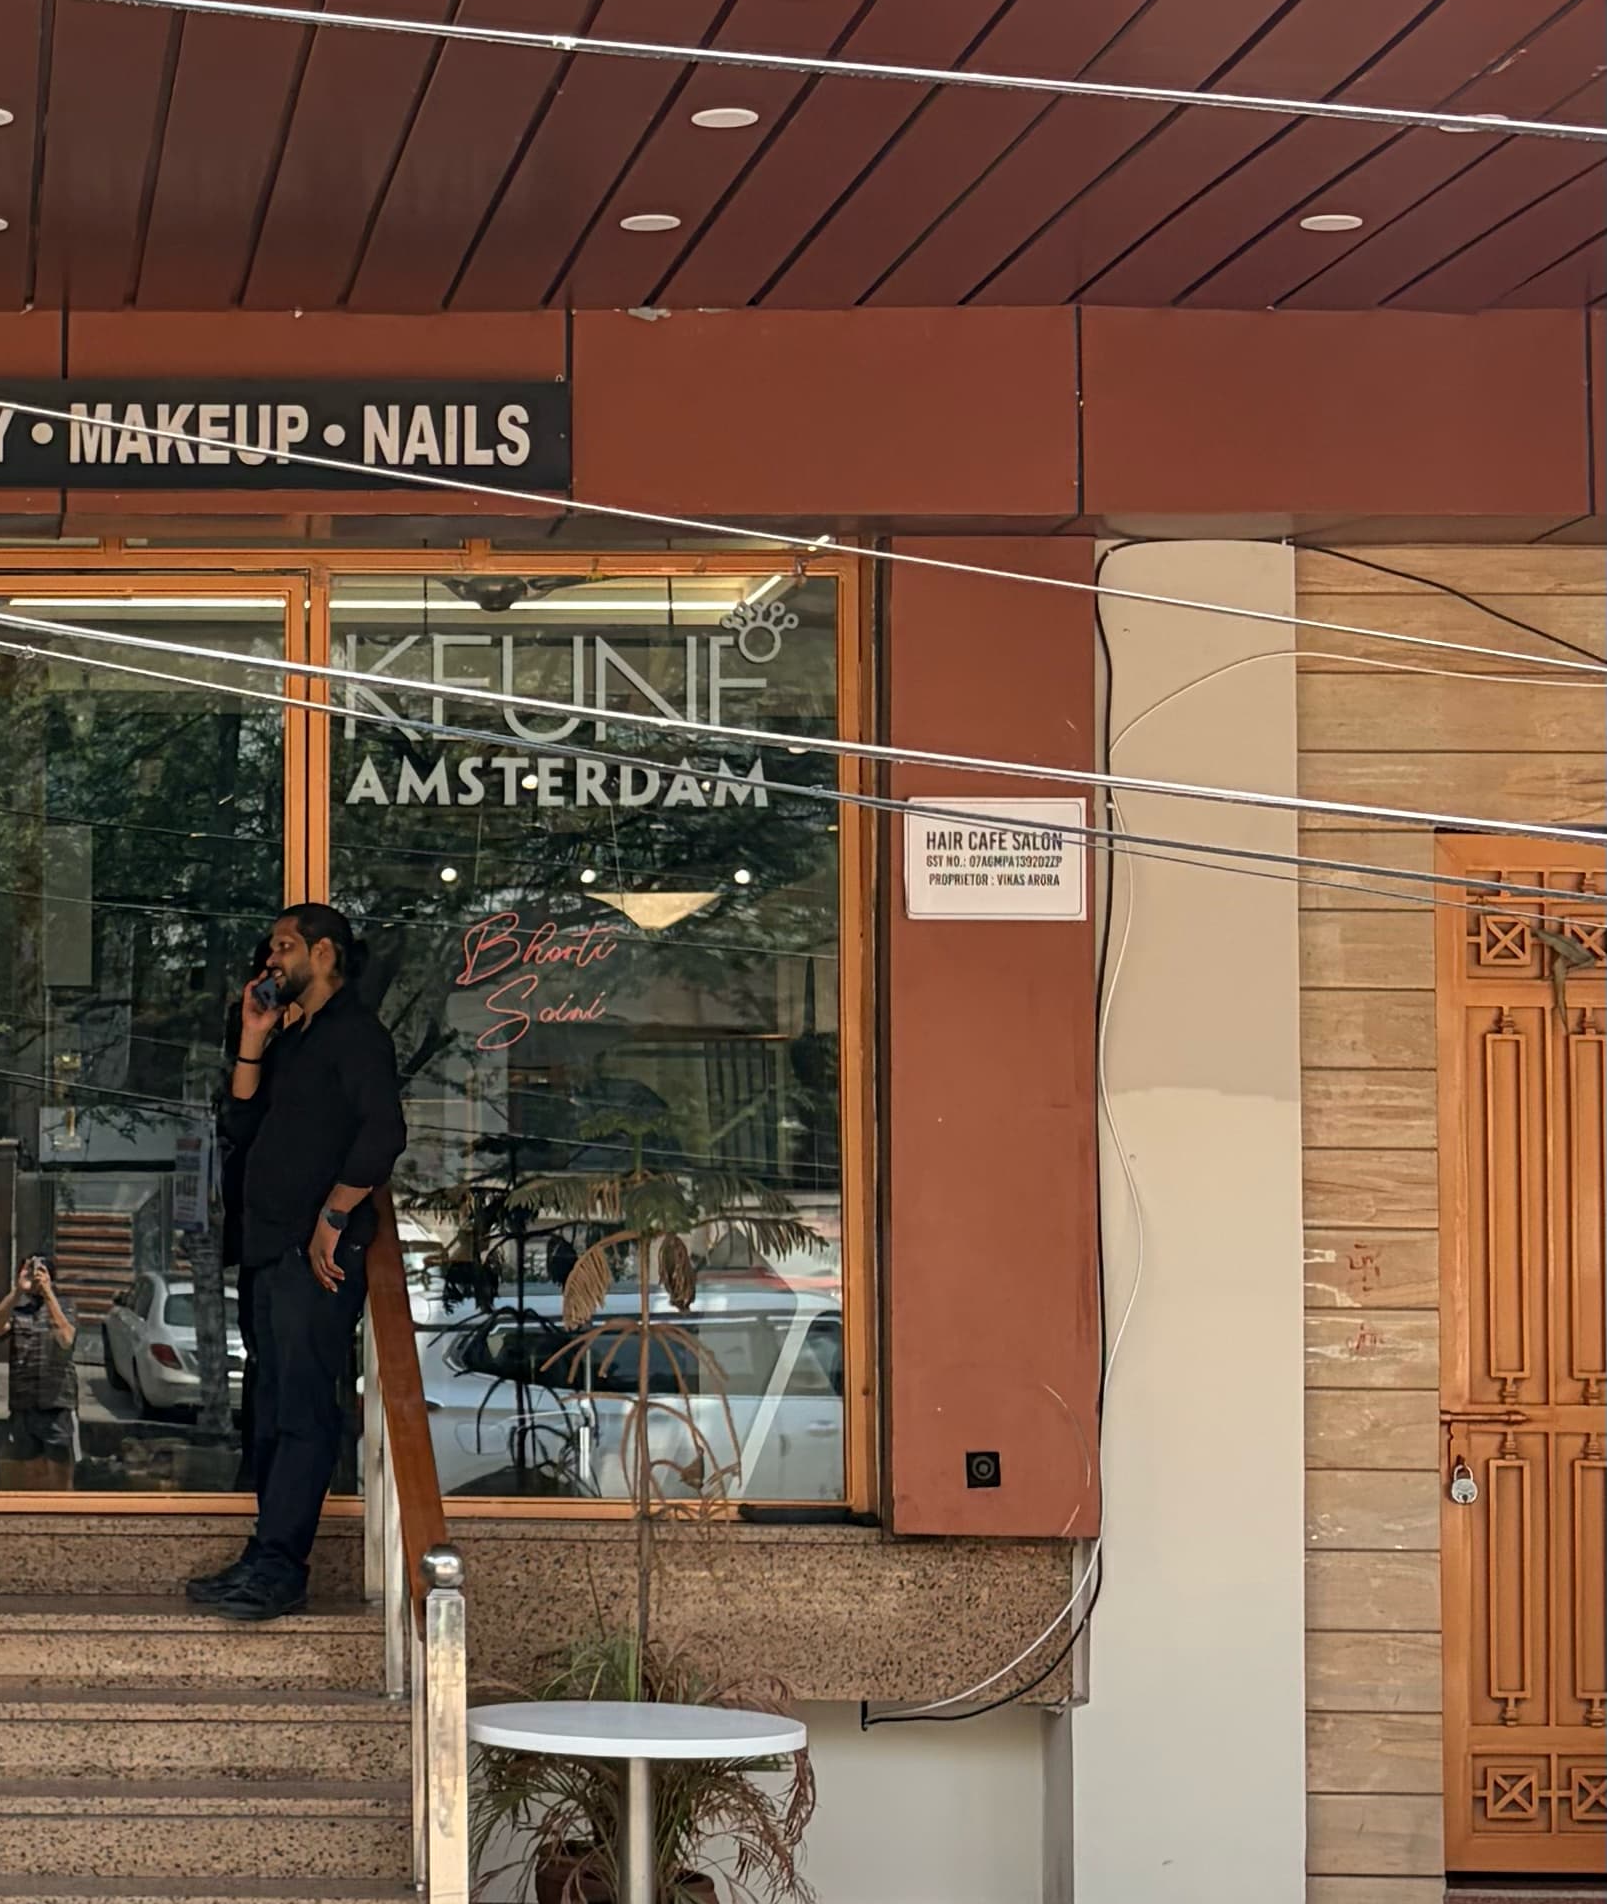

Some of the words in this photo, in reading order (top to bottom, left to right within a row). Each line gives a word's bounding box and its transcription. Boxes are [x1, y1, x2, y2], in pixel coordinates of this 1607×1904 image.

[68, 402, 310, 466] MAKEUP
[362, 404, 531, 468] NAILS
[343, 634, 768, 742] KEUNE
[345, 754, 770, 808] AMSTERDAM
[926, 831, 963, 850] HAIR
[968, 831, 1007, 851] CAFE
[1012, 832, 1063, 851] SALON
[926, 855, 943, 868] GST
[929, 873, 988, 886] PROPRIETOR
[997, 873, 1025, 886] VIKAS
[1028, 874, 1060, 886] ARORA
